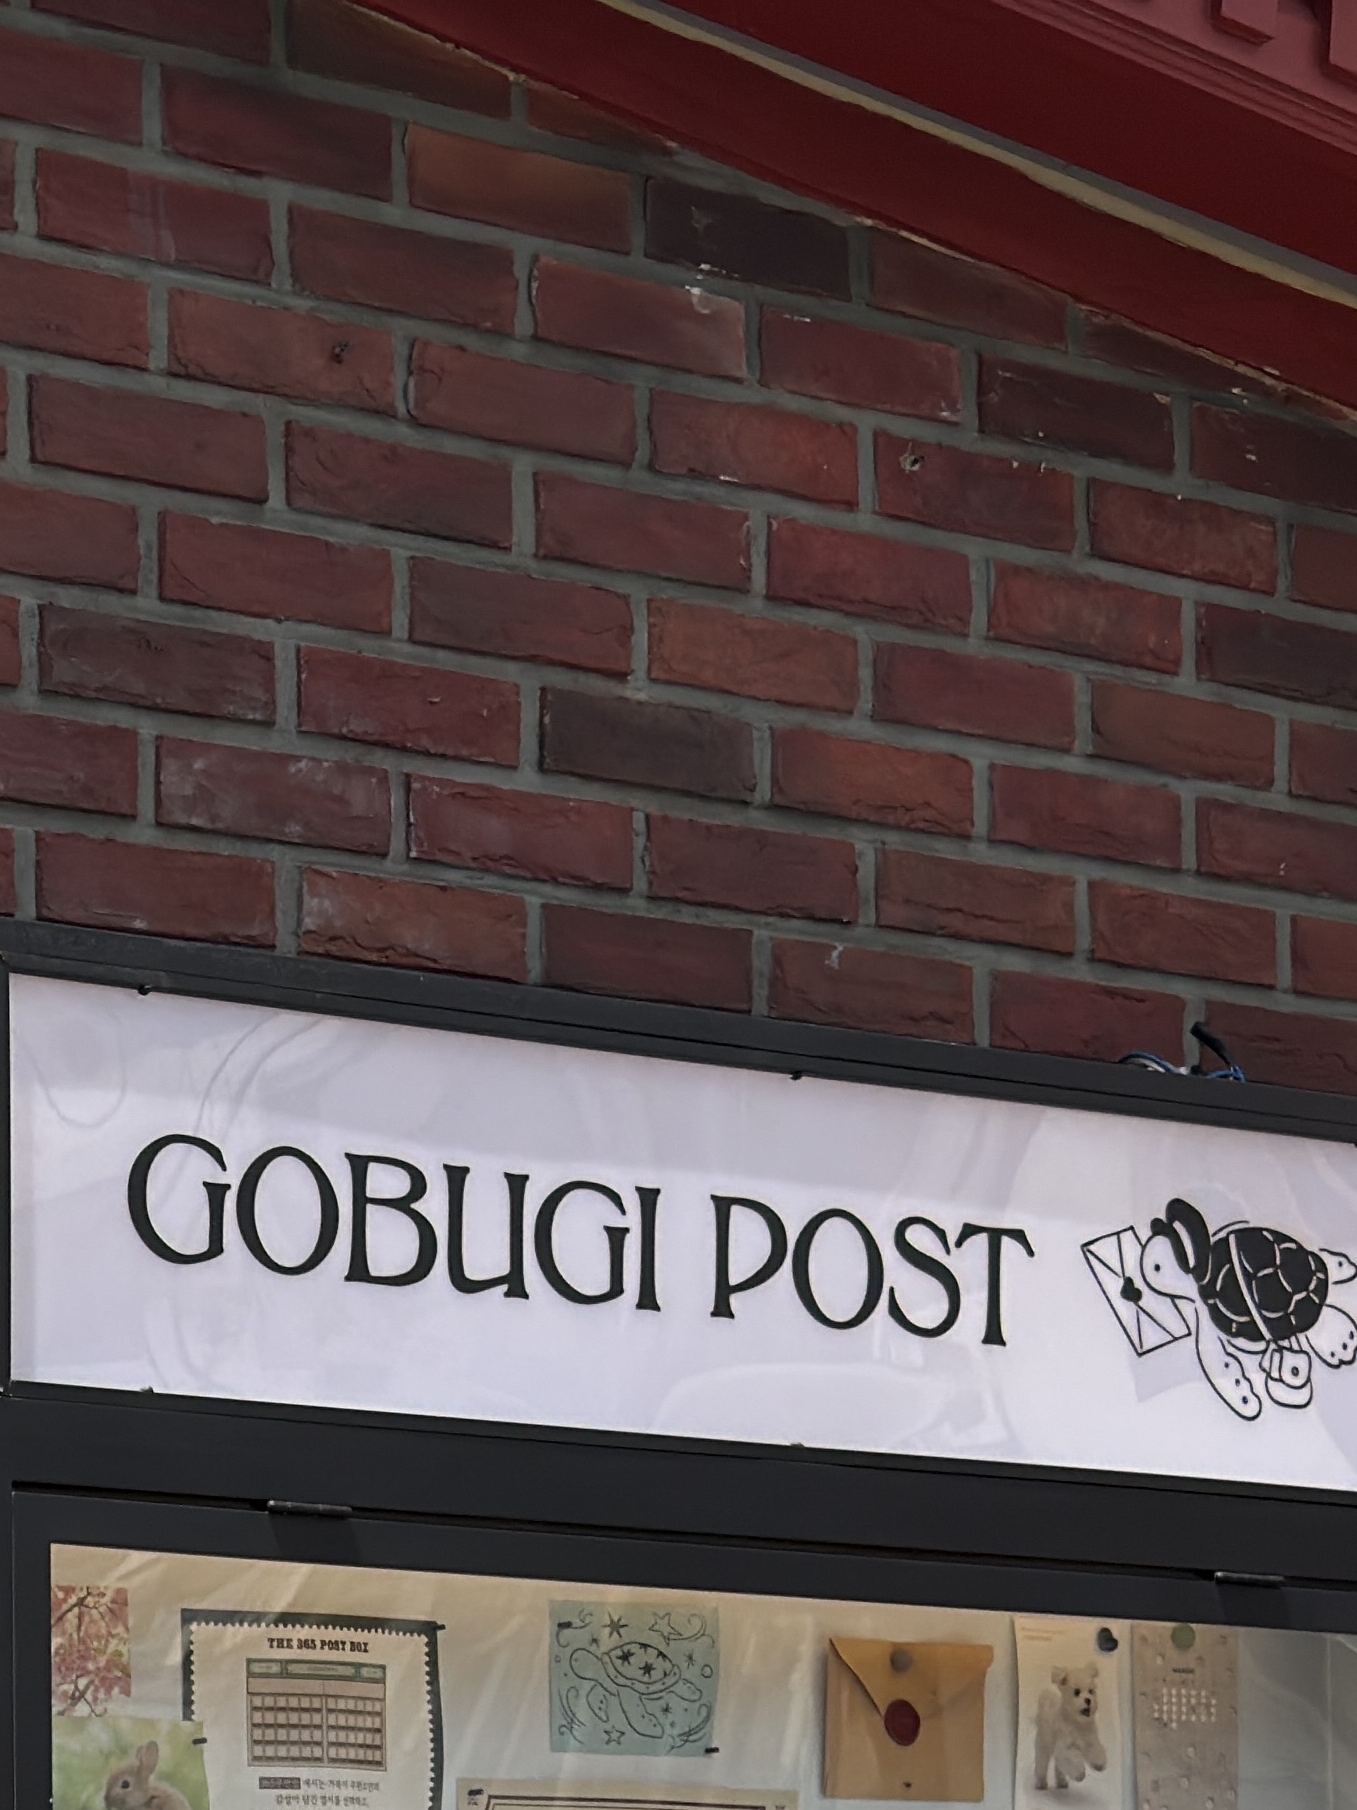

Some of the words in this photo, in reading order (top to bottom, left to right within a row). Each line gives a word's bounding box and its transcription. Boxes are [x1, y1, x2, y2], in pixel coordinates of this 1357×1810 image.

[127, 1132, 664, 1311] GOBUGI
[710, 1193, 1034, 1347] POST
[268, 1637, 293, 1649] THE
[297, 1638, 316, 1650] 365
[320, 1639, 346, 1651] POST
[349, 1641, 369, 1653] BOX
